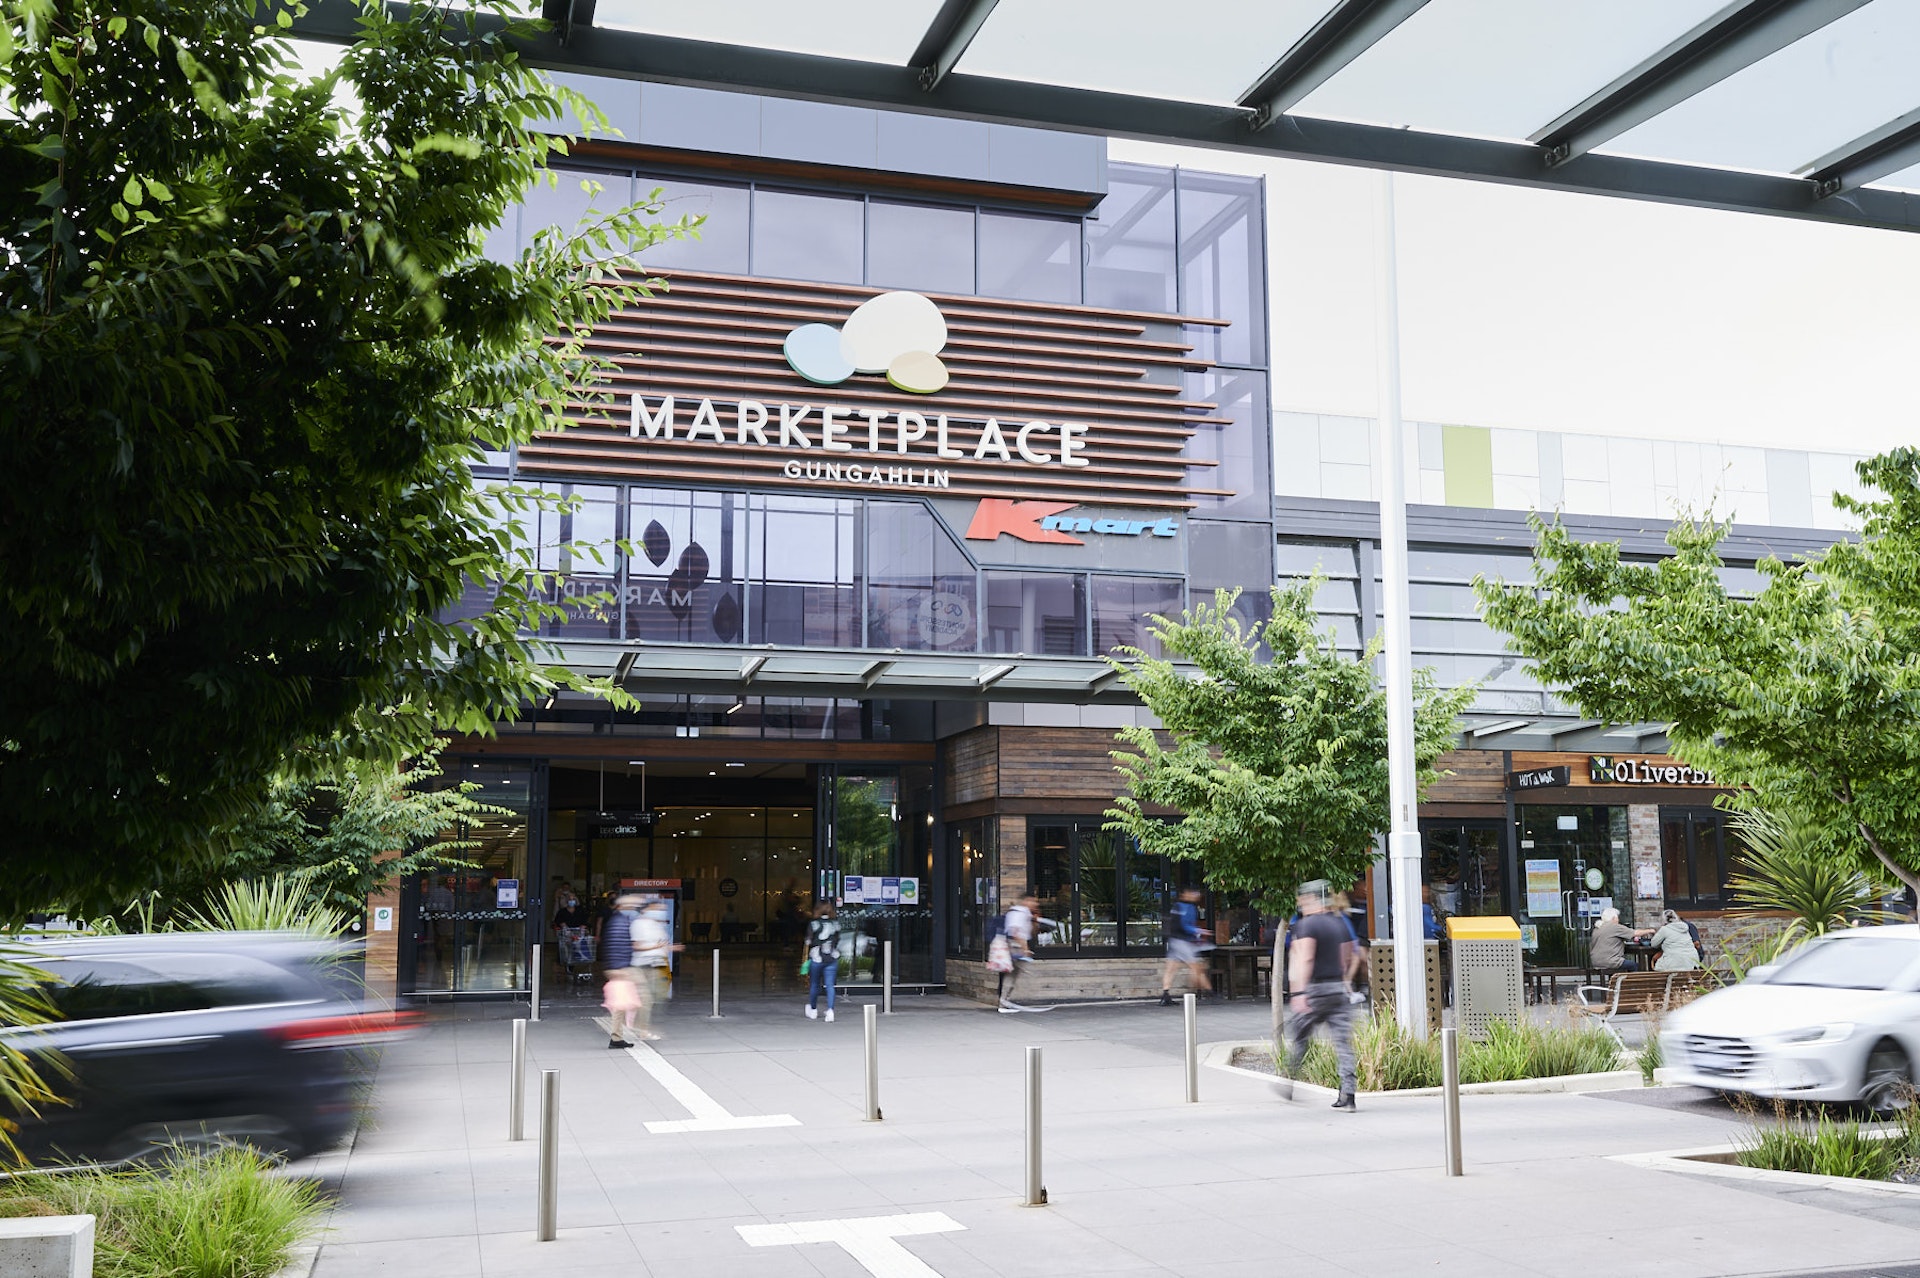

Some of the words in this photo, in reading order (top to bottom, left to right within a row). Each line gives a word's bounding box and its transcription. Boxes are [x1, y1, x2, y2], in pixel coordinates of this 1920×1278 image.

[629, 392, 1089, 466] MARKETPLACE
[784, 459, 949, 488] GUNGAHLIN
[965, 498, 1179, 545] Kmart
[1519, 772, 1534, 787] HOT
[634, 879, 669, 887] DIRECTORY
